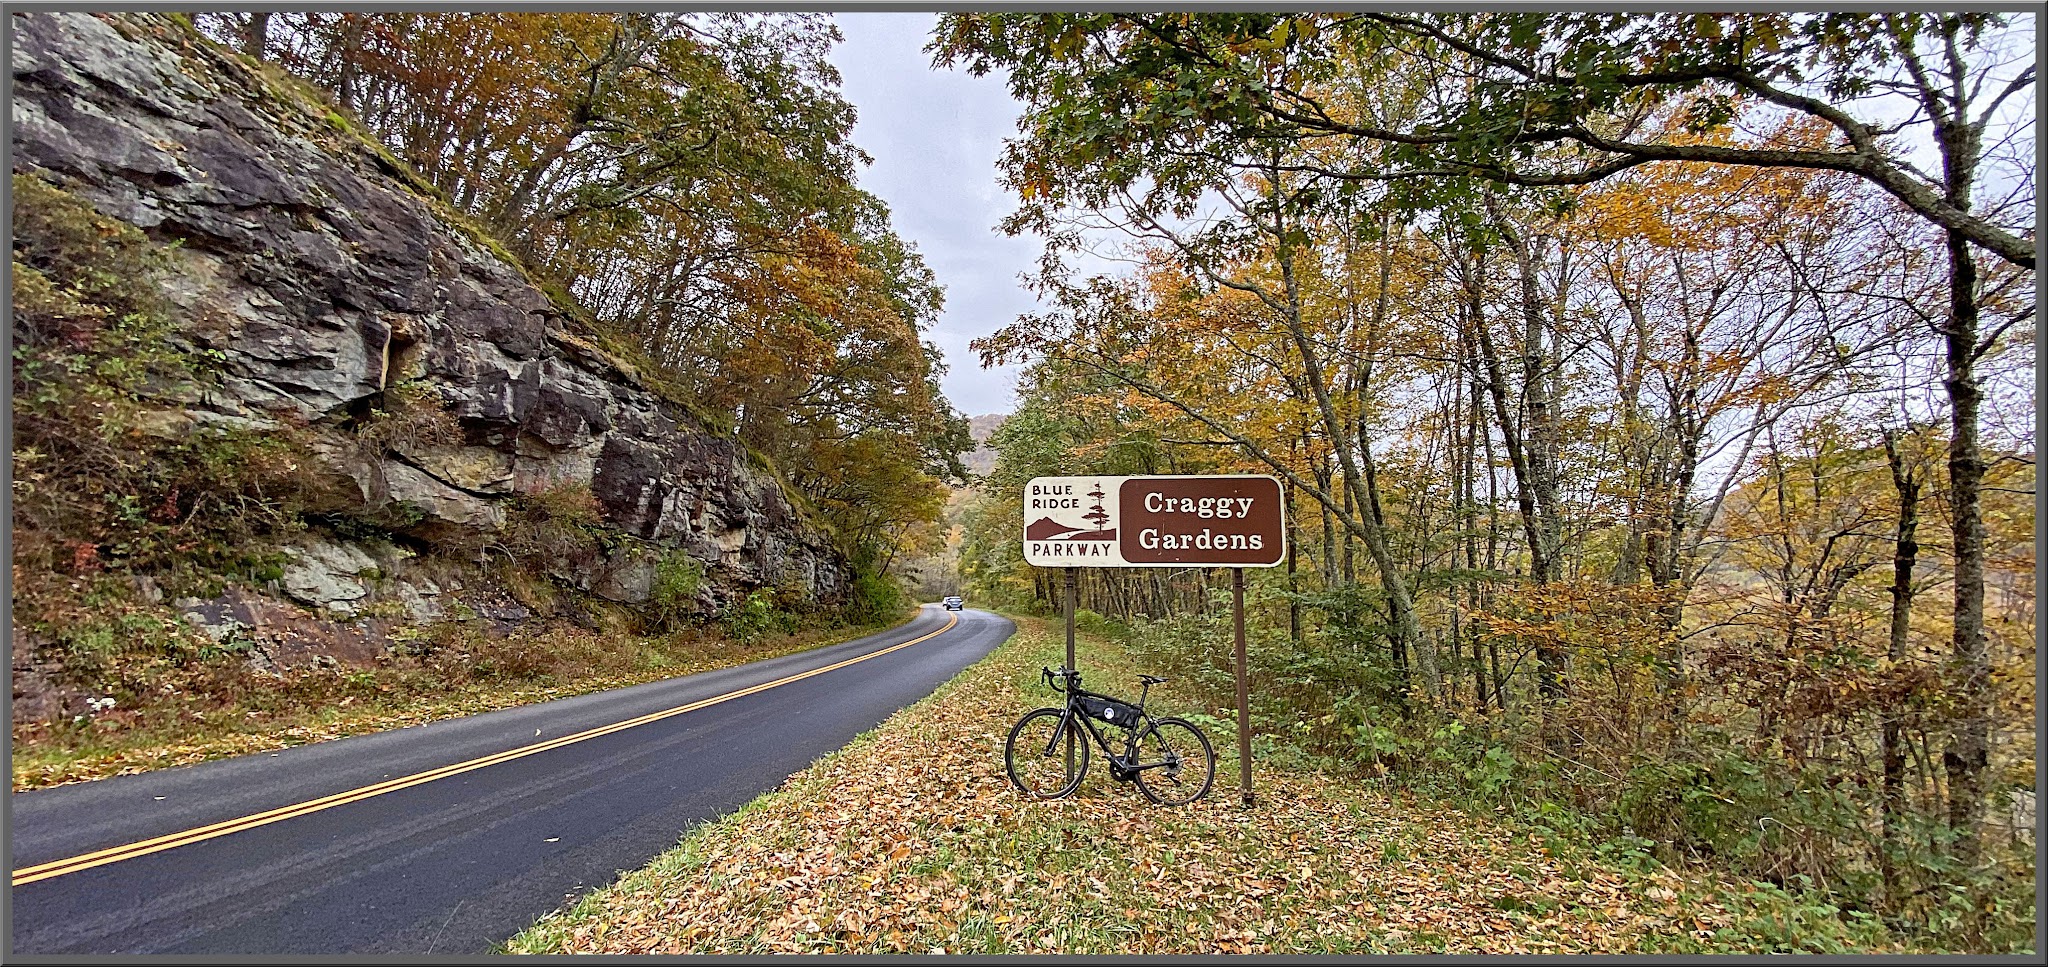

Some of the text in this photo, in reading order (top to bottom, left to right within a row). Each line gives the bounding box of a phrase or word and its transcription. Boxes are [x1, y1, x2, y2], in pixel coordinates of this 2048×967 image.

[1032, 485, 1073, 496] BLUE
[1032, 498, 1080, 509] RIDGE
[1144, 492, 1254, 518] Craggy
[1139, 528, 1263, 550] Gardens
[1032, 543, 1111, 557] PARKWAY
